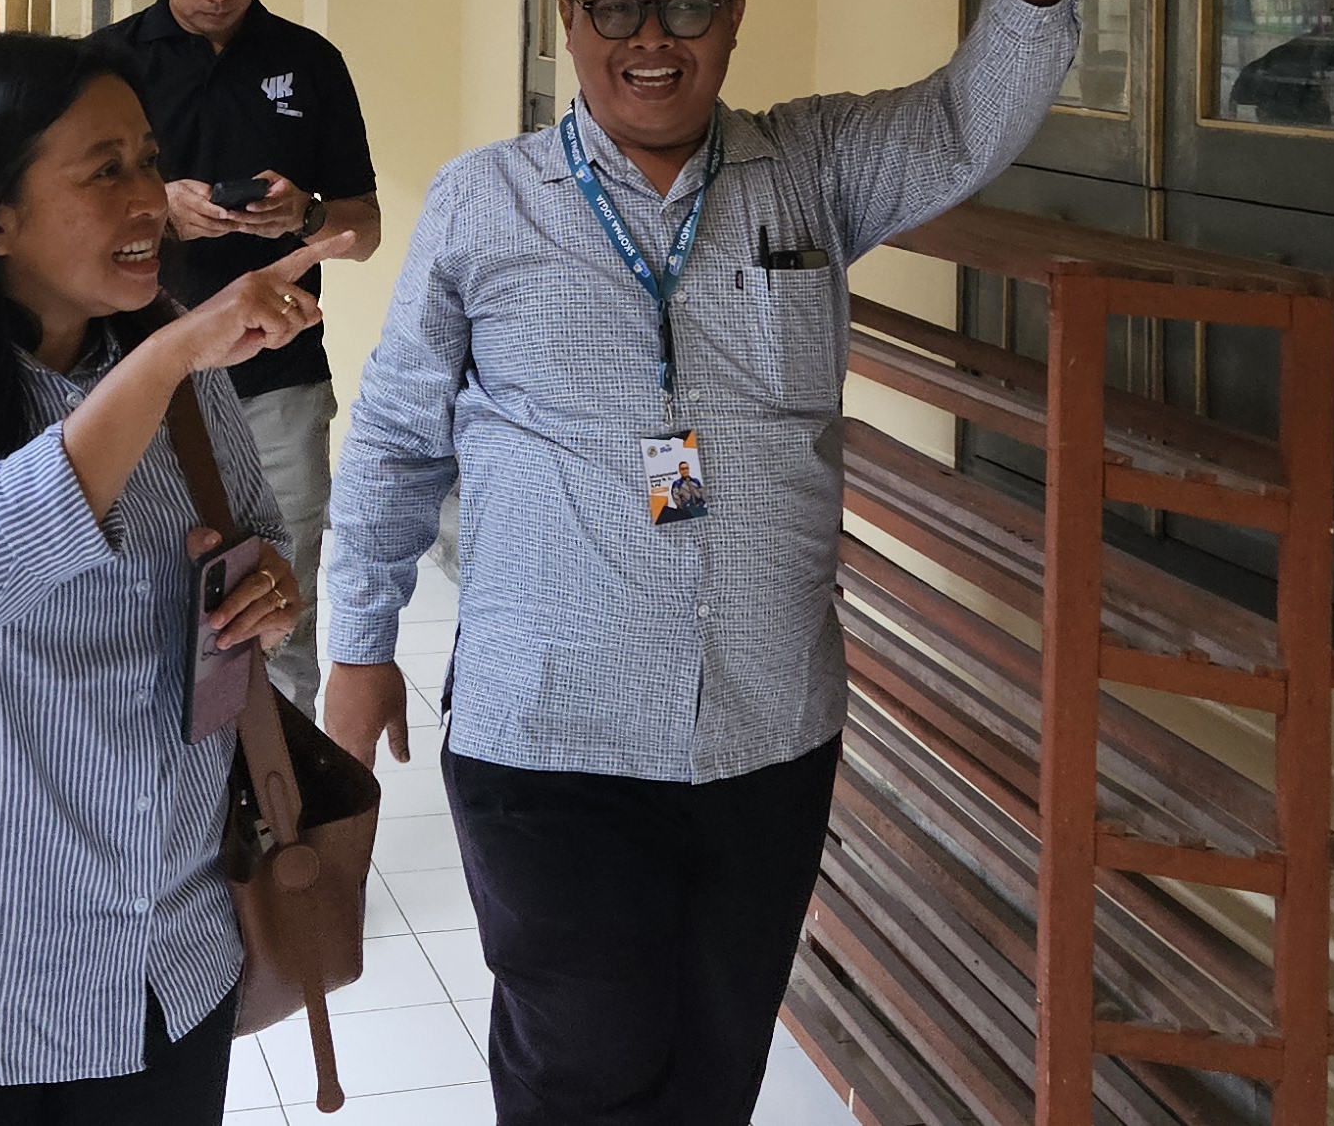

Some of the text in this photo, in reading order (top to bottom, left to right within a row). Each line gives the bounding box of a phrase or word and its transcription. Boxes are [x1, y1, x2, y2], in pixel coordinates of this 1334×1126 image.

[261, 72, 293, 101] YK
[595, 193, 637, 257] SKOPMA JOGJA
[677, 214, 695, 251] SKOPMA
